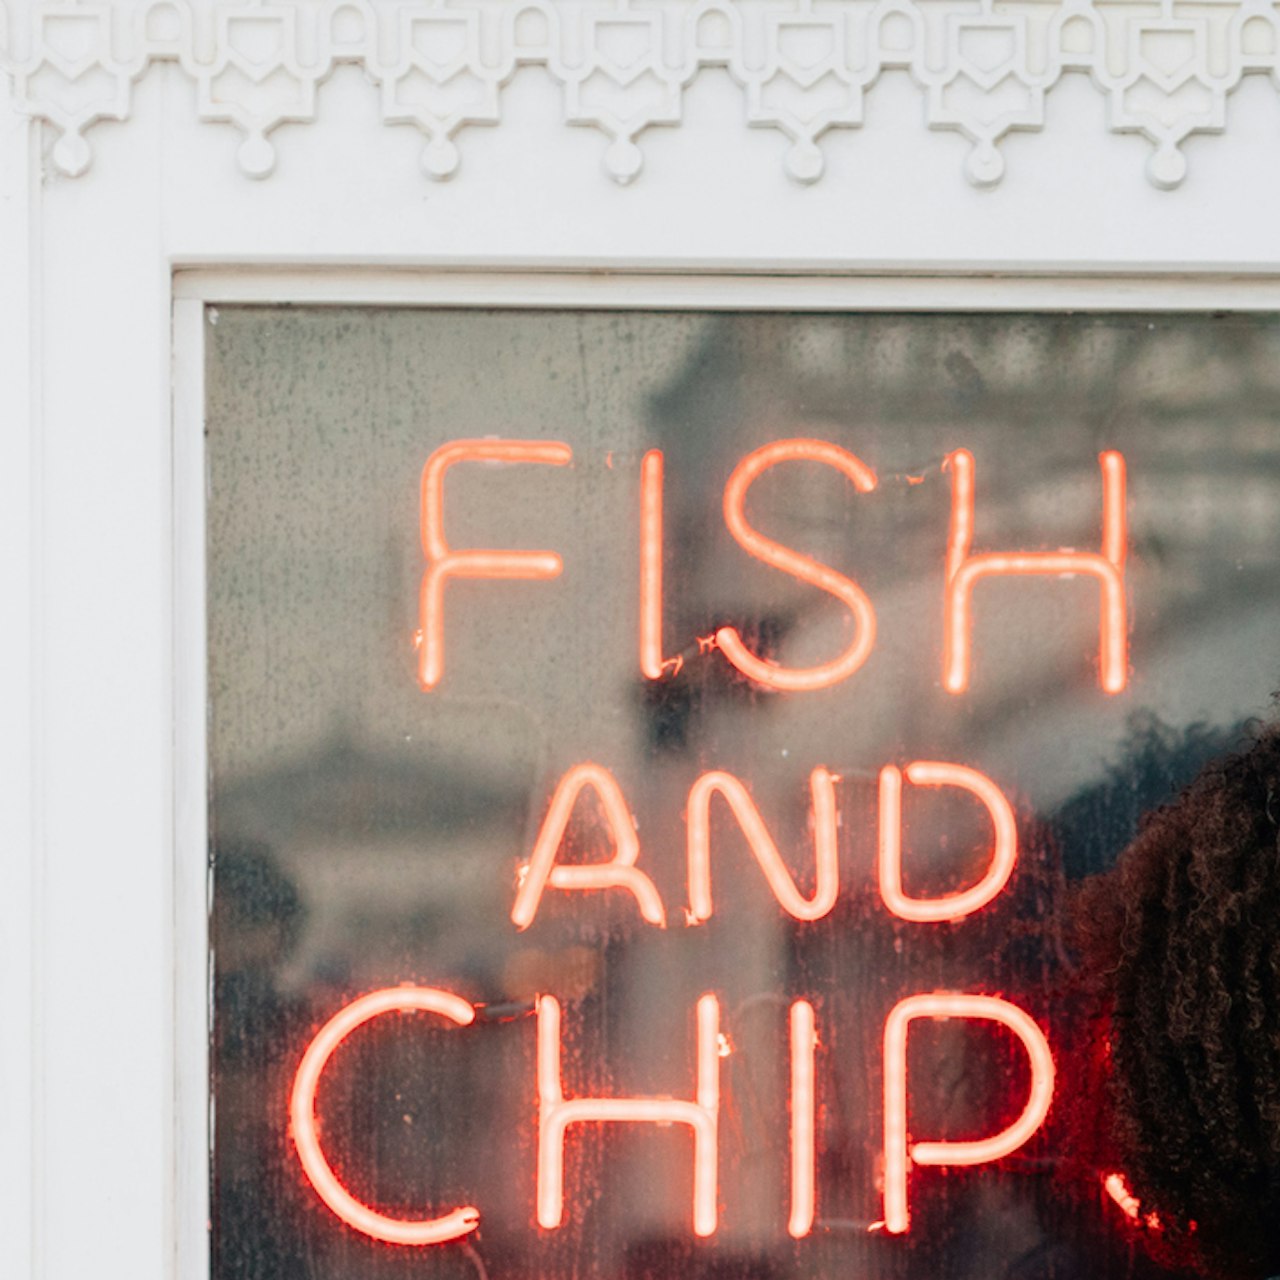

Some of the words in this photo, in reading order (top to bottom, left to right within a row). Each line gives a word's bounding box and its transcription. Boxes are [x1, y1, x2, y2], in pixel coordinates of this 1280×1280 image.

[419, 437, 1130, 693] FISH
[511, 763, 1017, 928] AND
[290, 986, 1140, 1246] CHIP
